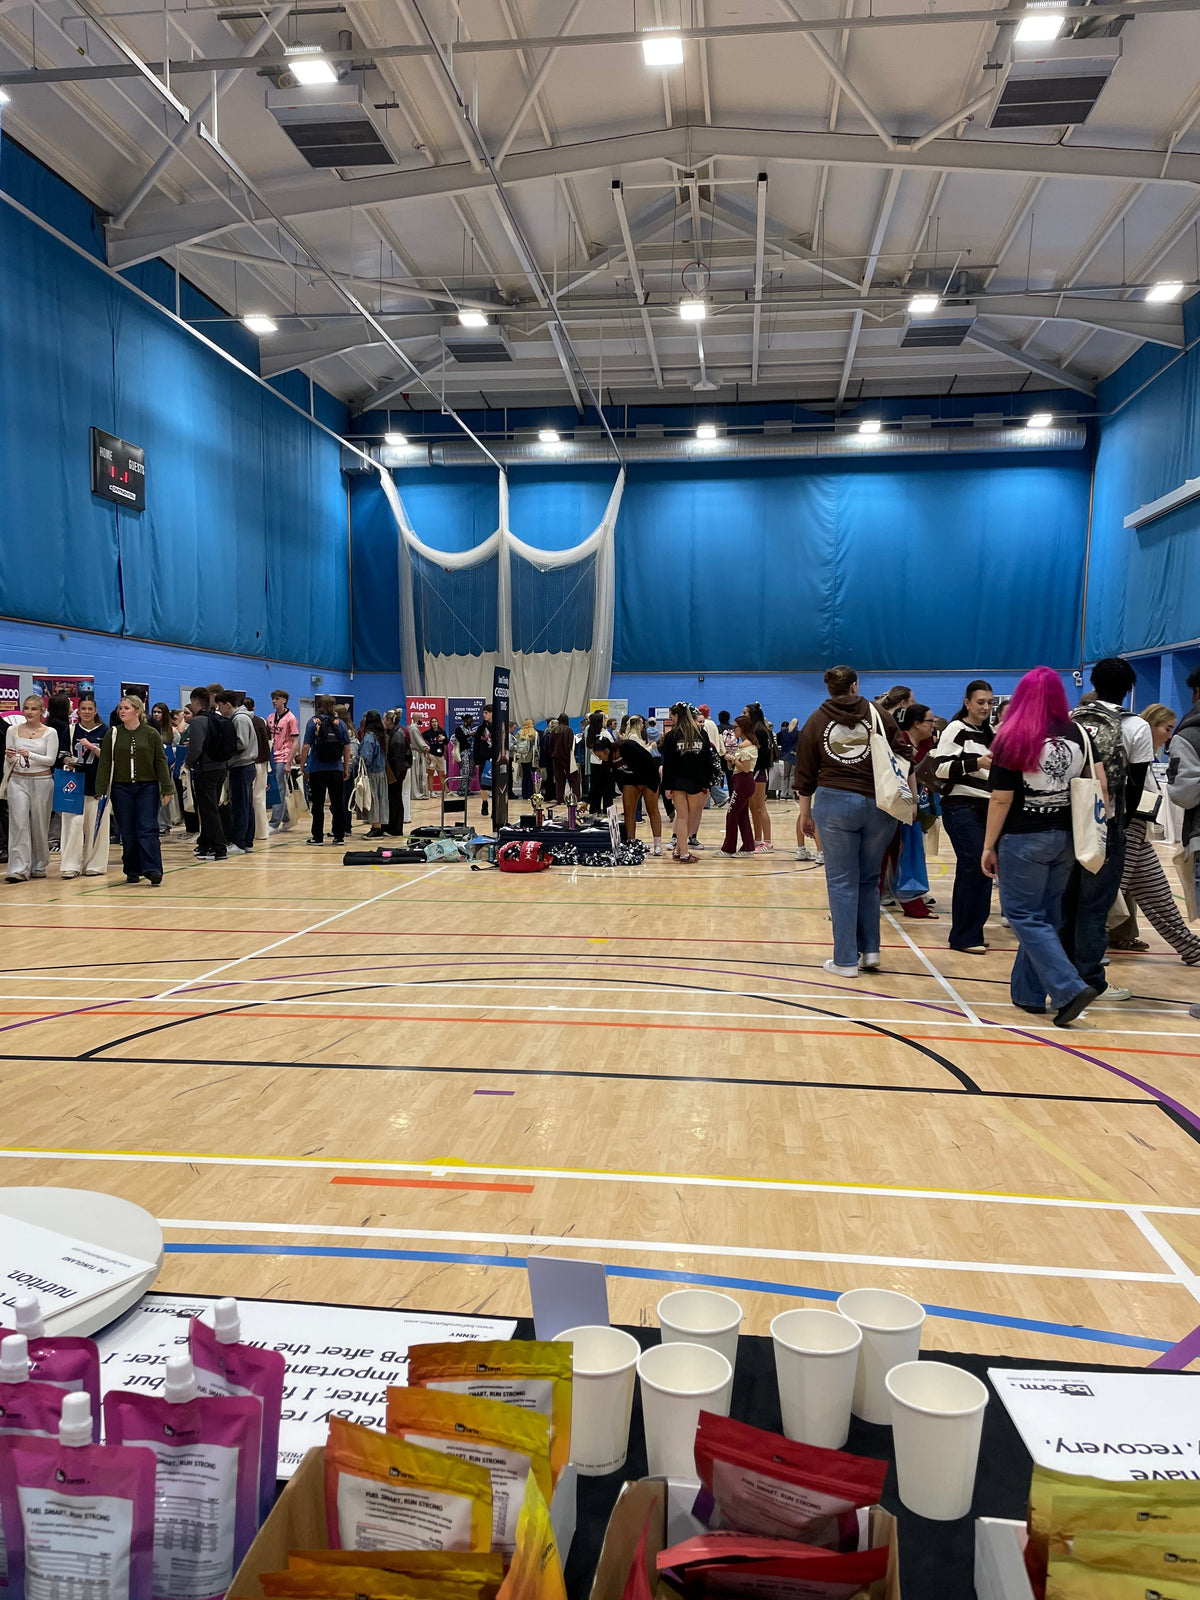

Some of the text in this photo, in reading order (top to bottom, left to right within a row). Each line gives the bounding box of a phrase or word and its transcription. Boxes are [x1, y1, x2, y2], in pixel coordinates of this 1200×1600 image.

[100, 446, 112, 461] HOME
[410, 701, 436, 711] Alpha
[273, 1342, 312, 1356] the
[316, 1346, 375, 1360] after
[380, 1350, 411, 1364] PB
[123, 1375, 166, 1391] but
[1046, 1437, 1184, 1455] recovery.
[194, 1460, 216, 1470] STRONG
[482, 1456, 506, 1465] STRONG
[366, 1491, 444, 1512] FUEL SMART, RUN STRONG
[780, 1492, 794, 1502] RUN
[794, 1496, 822, 1510] STRONG
[84, 1512, 110, 1522] STRONG
